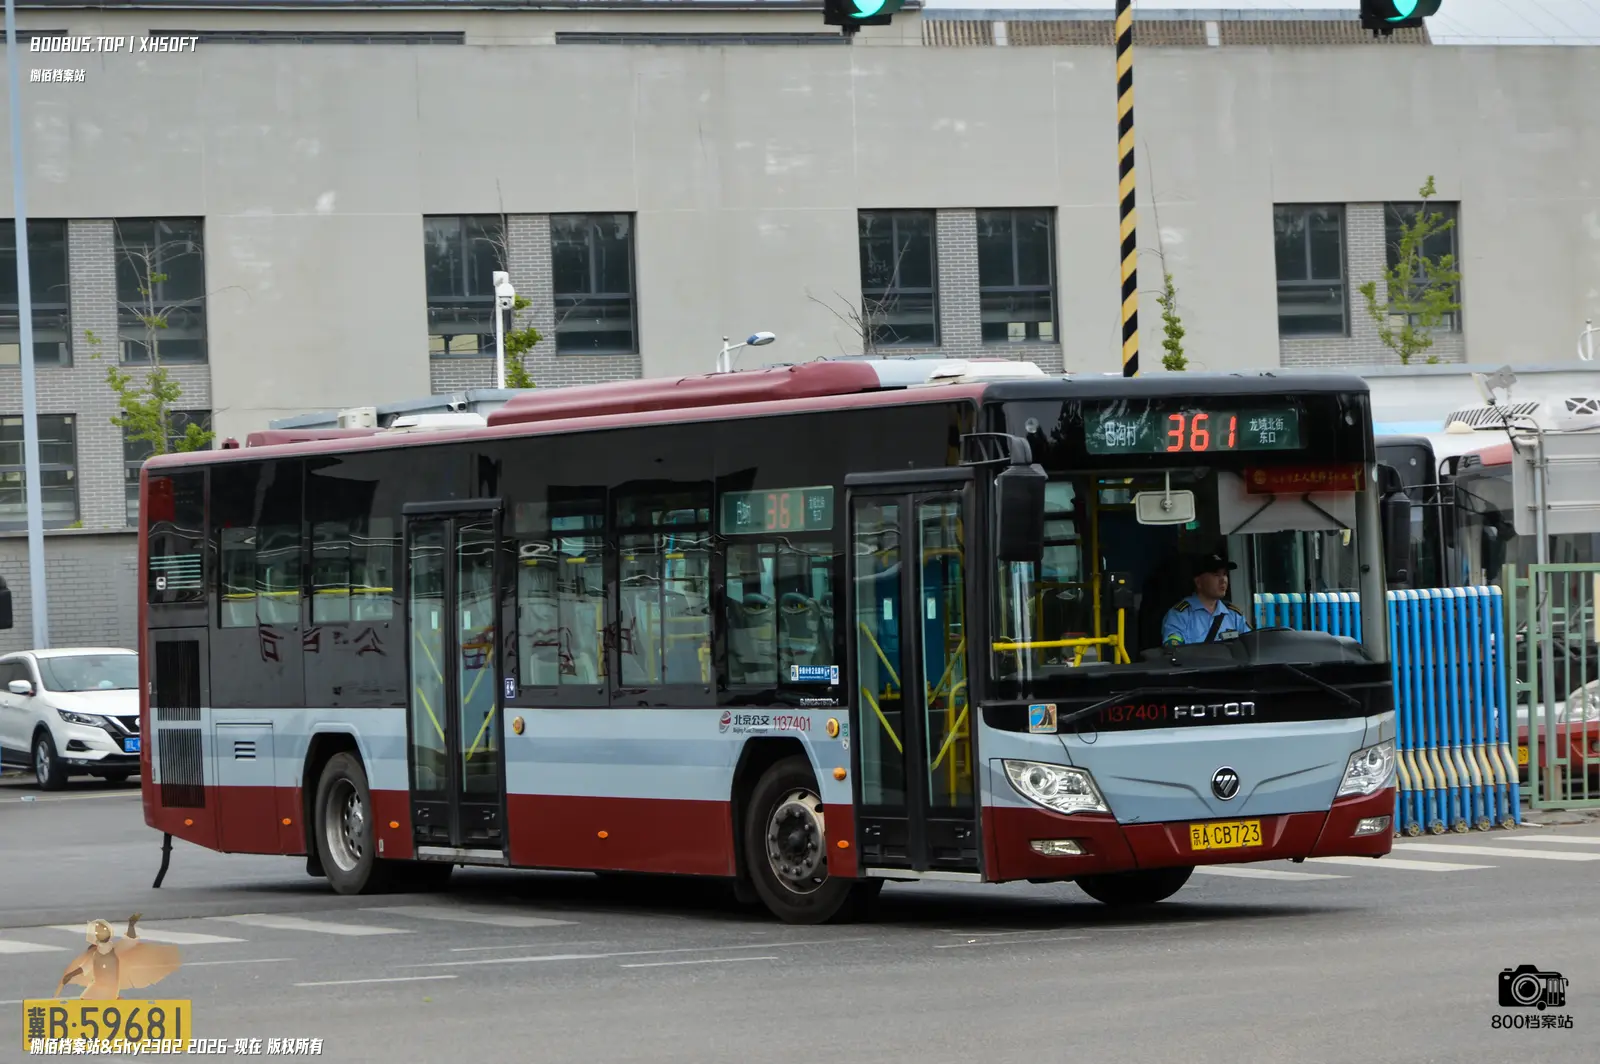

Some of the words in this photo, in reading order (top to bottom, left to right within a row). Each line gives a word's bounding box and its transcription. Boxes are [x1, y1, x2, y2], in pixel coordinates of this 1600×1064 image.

[1167, 414, 1237, 452] 361
[1259, 432, 1276, 444] 东口
[767, 493, 805, 530] 361
[1100, 705, 1167, 722] 1137401
[1174, 702, 1255, 719] FOTON
[734, 715, 770, 726] 北京公交
[773, 715, 811, 731] 1137401
